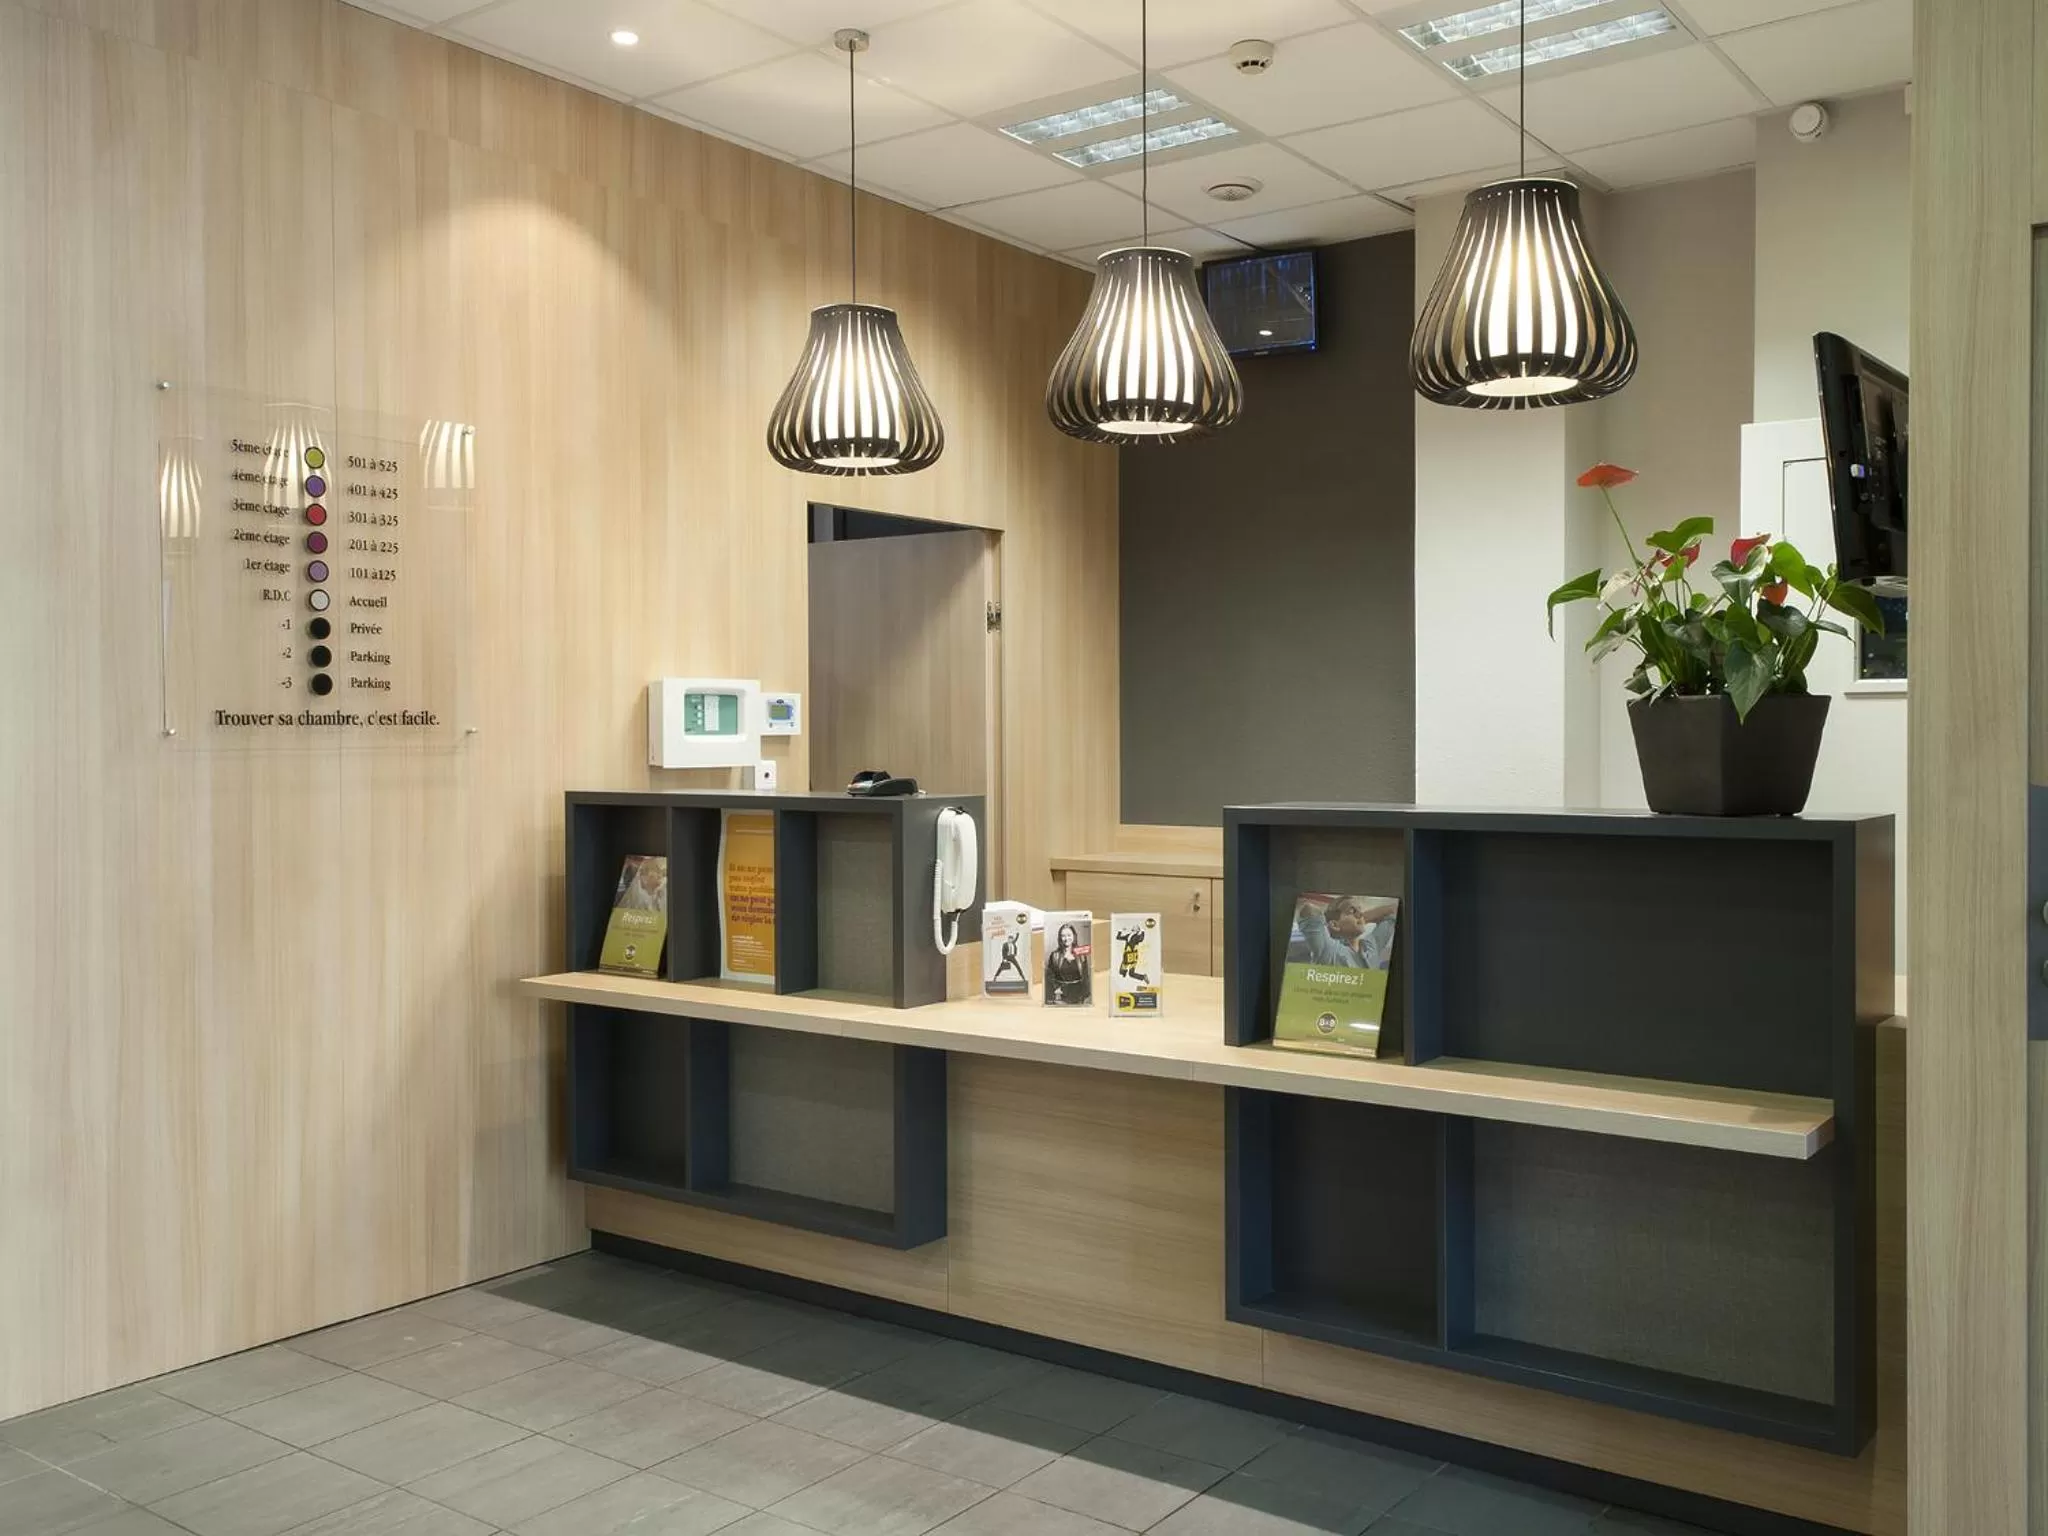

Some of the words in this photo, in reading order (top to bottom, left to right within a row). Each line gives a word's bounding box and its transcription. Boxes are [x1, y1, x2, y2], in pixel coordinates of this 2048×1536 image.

[348, 455, 366, 468] 501
[370, 458, 377, 470] à
[379, 460, 398, 473] 525
[347, 483, 367, 496] 401
[370, 485, 377, 497] à
[379, 487, 398, 500] 425
[232, 498, 260, 512] 3ème
[349, 511, 367, 524] 301
[371, 512, 377, 525] à
[379, 514, 398, 527] 325
[233, 528, 260, 541] 2ème
[263, 531, 290, 546] étage
[349, 539, 368, 551] 201
[371, 540, 377, 552] à
[380, 541, 399, 555] 225
[245, 558, 261, 570] 1er
[264, 559, 291, 575] étage
[351, 567, 368, 579] 101
[349, 596, 388, 608] Accueil
[282, 619, 291, 630] -1
[350, 622, 382, 635] Privée
[282, 647, 292, 659] -2
[350, 650, 391, 665] Parking
[281, 676, 292, 689] -3
[350, 677, 391, 691] Parking
[215, 709, 274, 726] Trouver
[278, 713, 293, 726] sa
[298, 709, 364, 727] chambre,
[367, 710, 398, 726] c'est
[401, 709, 440, 726] facile.
